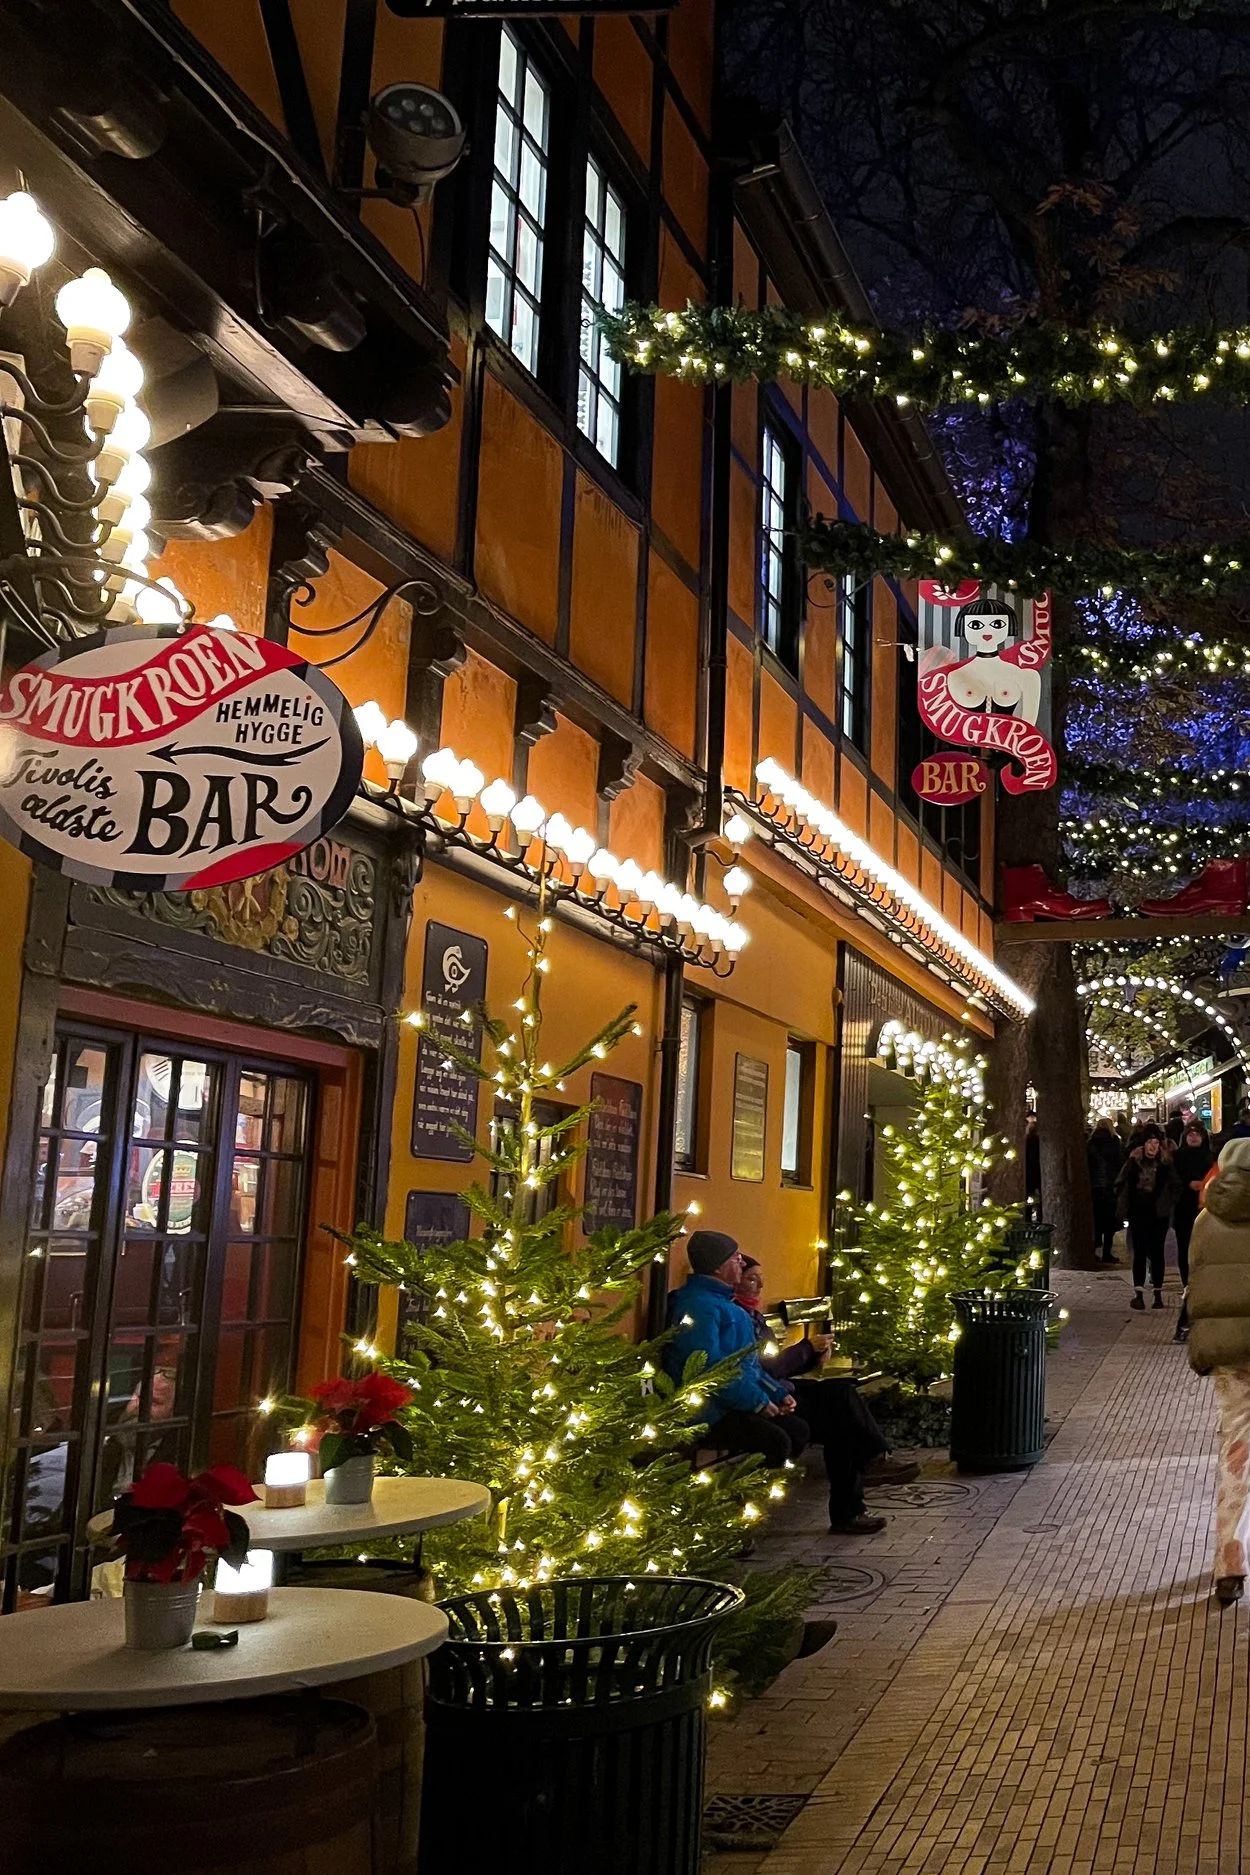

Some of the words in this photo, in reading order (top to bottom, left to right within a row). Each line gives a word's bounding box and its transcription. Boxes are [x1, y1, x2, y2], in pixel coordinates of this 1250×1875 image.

[0, 629, 267, 742] SMUGKROEN
[235, 721, 303, 744] HYGGE
[921, 673, 1052, 789] SMUGKROEN
[1, 749, 118, 800] Tivolis
[920, 761, 986, 795] BAR
[21, 794, 124, 842] ældste
[120, 770, 313, 858] BAR
